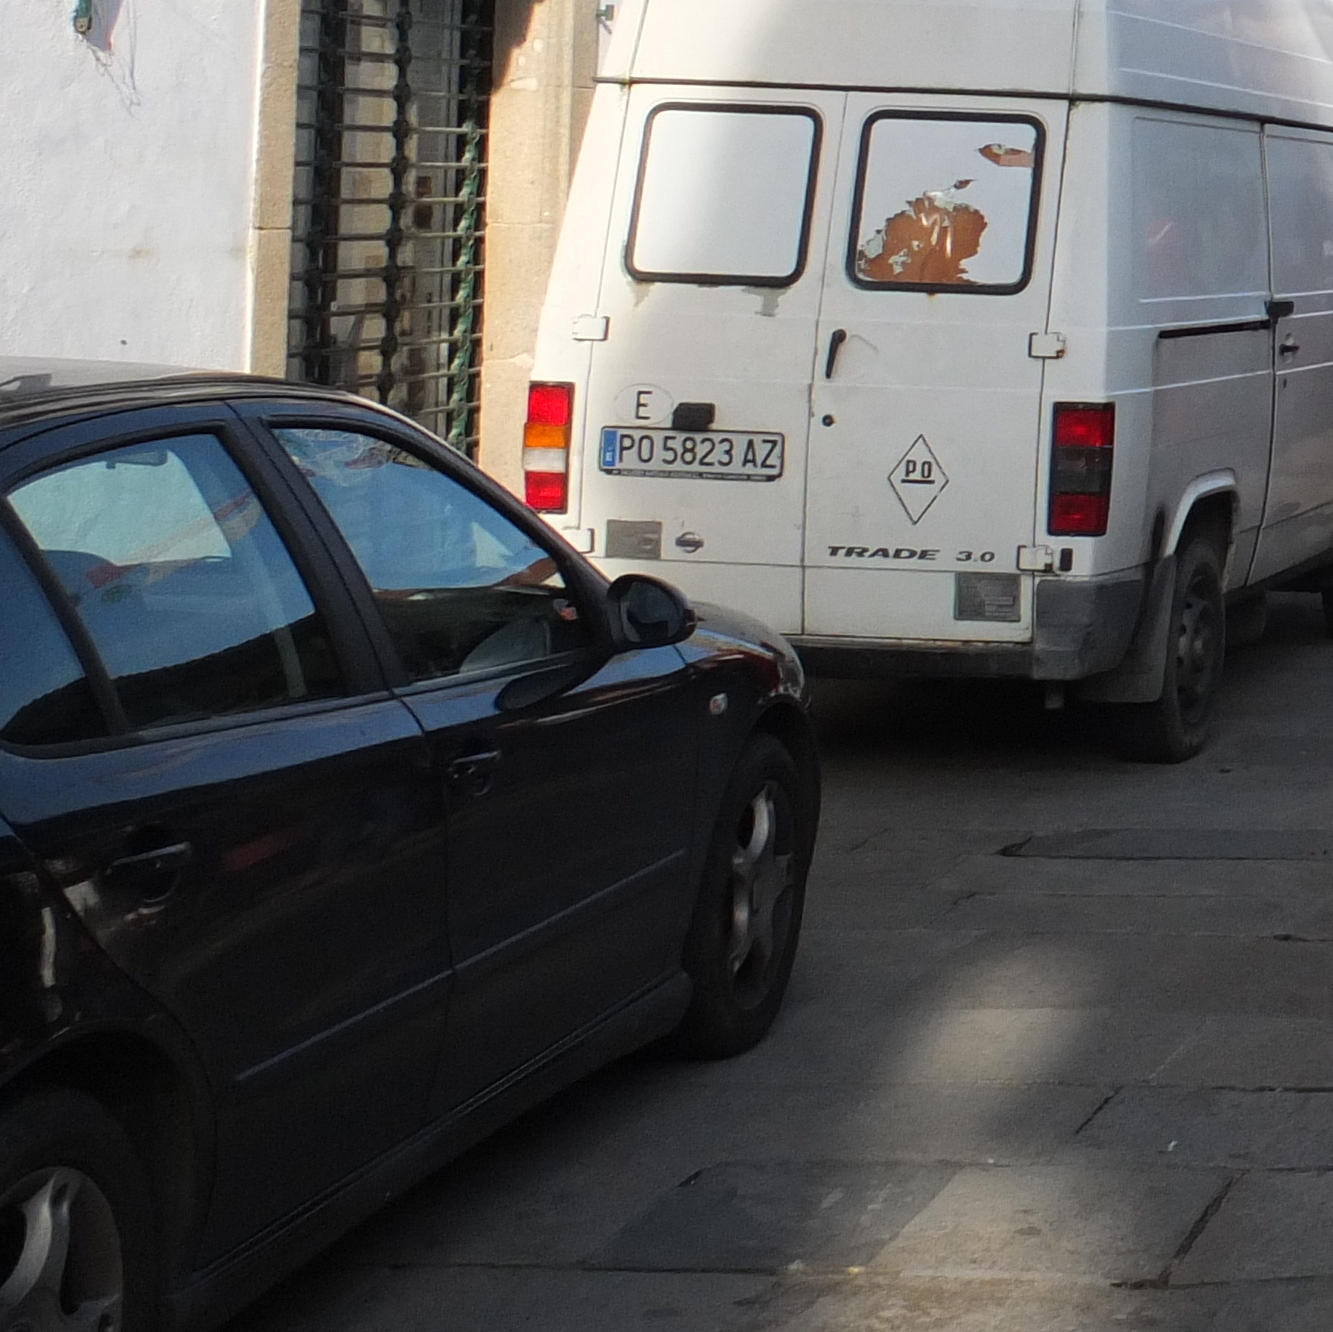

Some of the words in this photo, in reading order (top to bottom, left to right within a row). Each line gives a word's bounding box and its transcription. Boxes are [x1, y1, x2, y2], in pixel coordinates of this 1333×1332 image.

[635, 390, 653, 420] E
[618, 434, 654, 463] PO
[662, 435, 734, 466] 5823
[742, 438, 778, 468] AZ
[905, 459, 933, 479] PO
[828, 546, 940, 561] TRADE
[956, 550, 995, 563] 3.0
